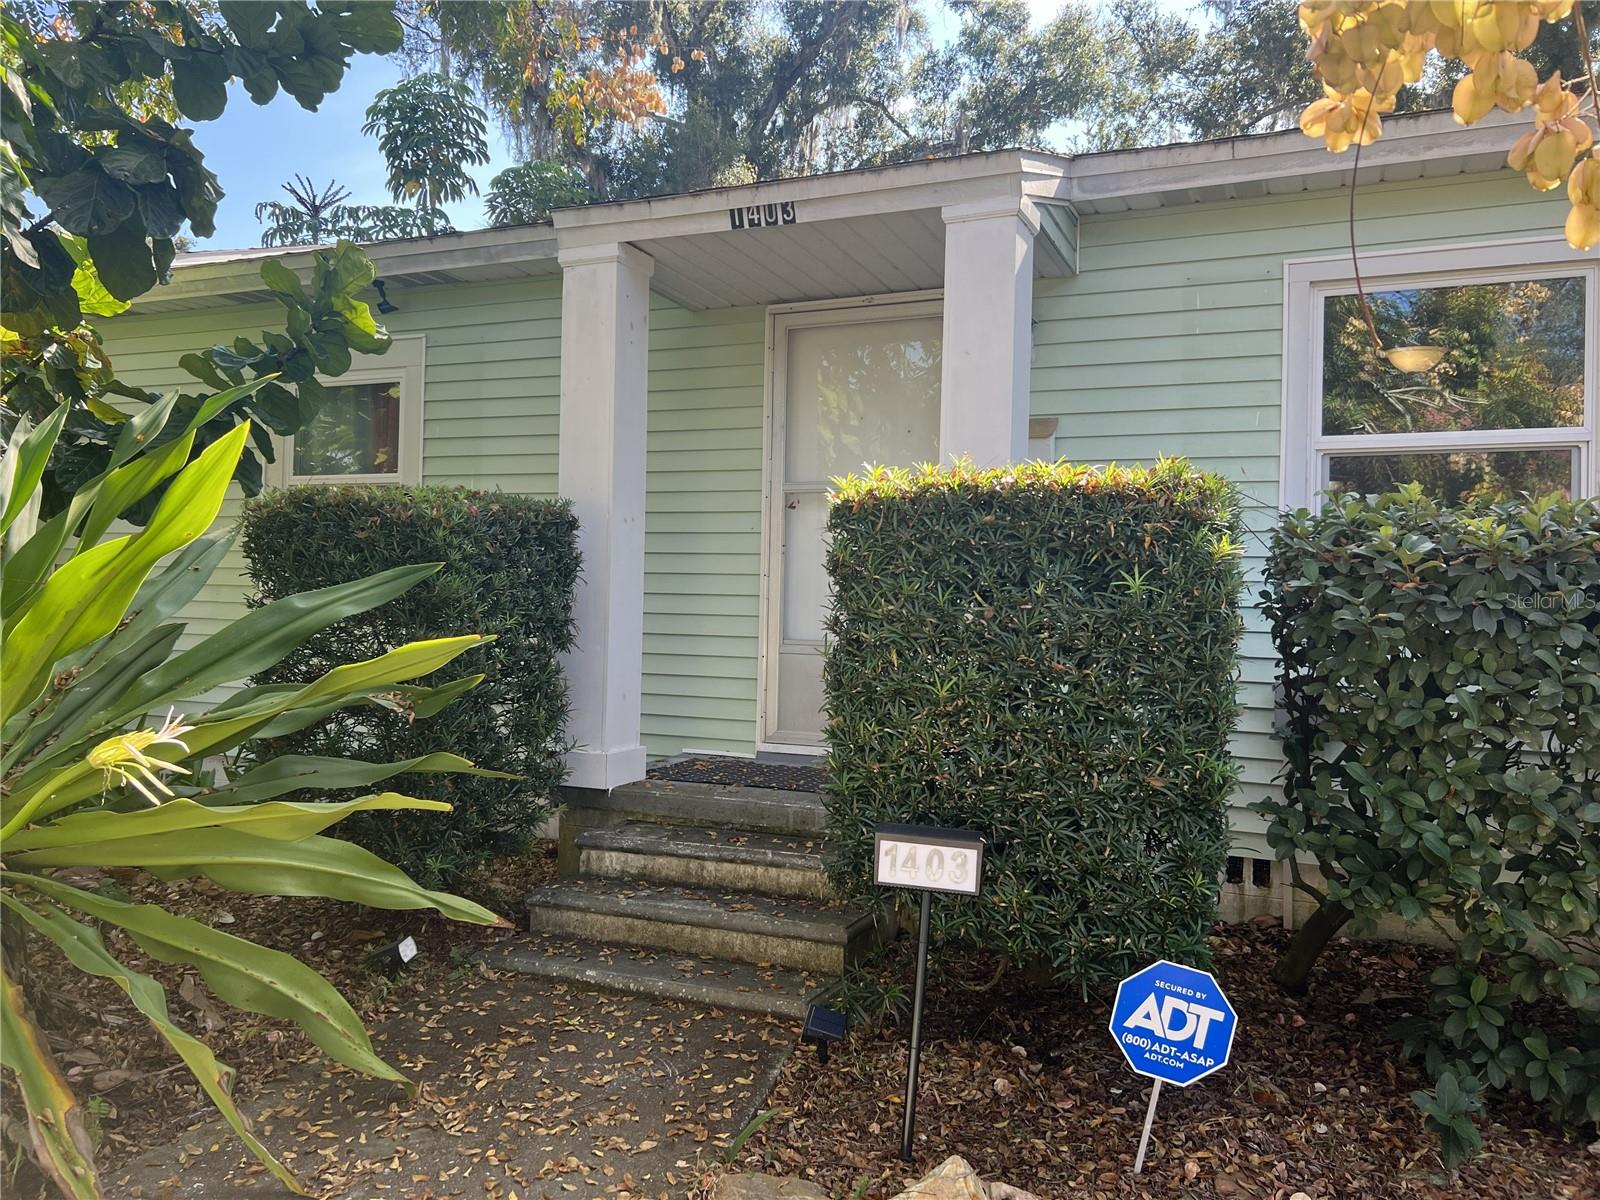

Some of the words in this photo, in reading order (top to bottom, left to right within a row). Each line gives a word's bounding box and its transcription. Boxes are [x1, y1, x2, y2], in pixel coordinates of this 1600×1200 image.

[884, 843, 969, 884] 1403
[1154, 980, 1194, 996] SECURED
[1195, 991, 1207, 1000] BY
[1122, 992, 1225, 1050] ADT
[1121, 1032, 1151, 1050] (800)
[1151, 1042, 1215, 1068] ADT-ASAP
[1143, 1051, 1185, 1069] ADT.COM
